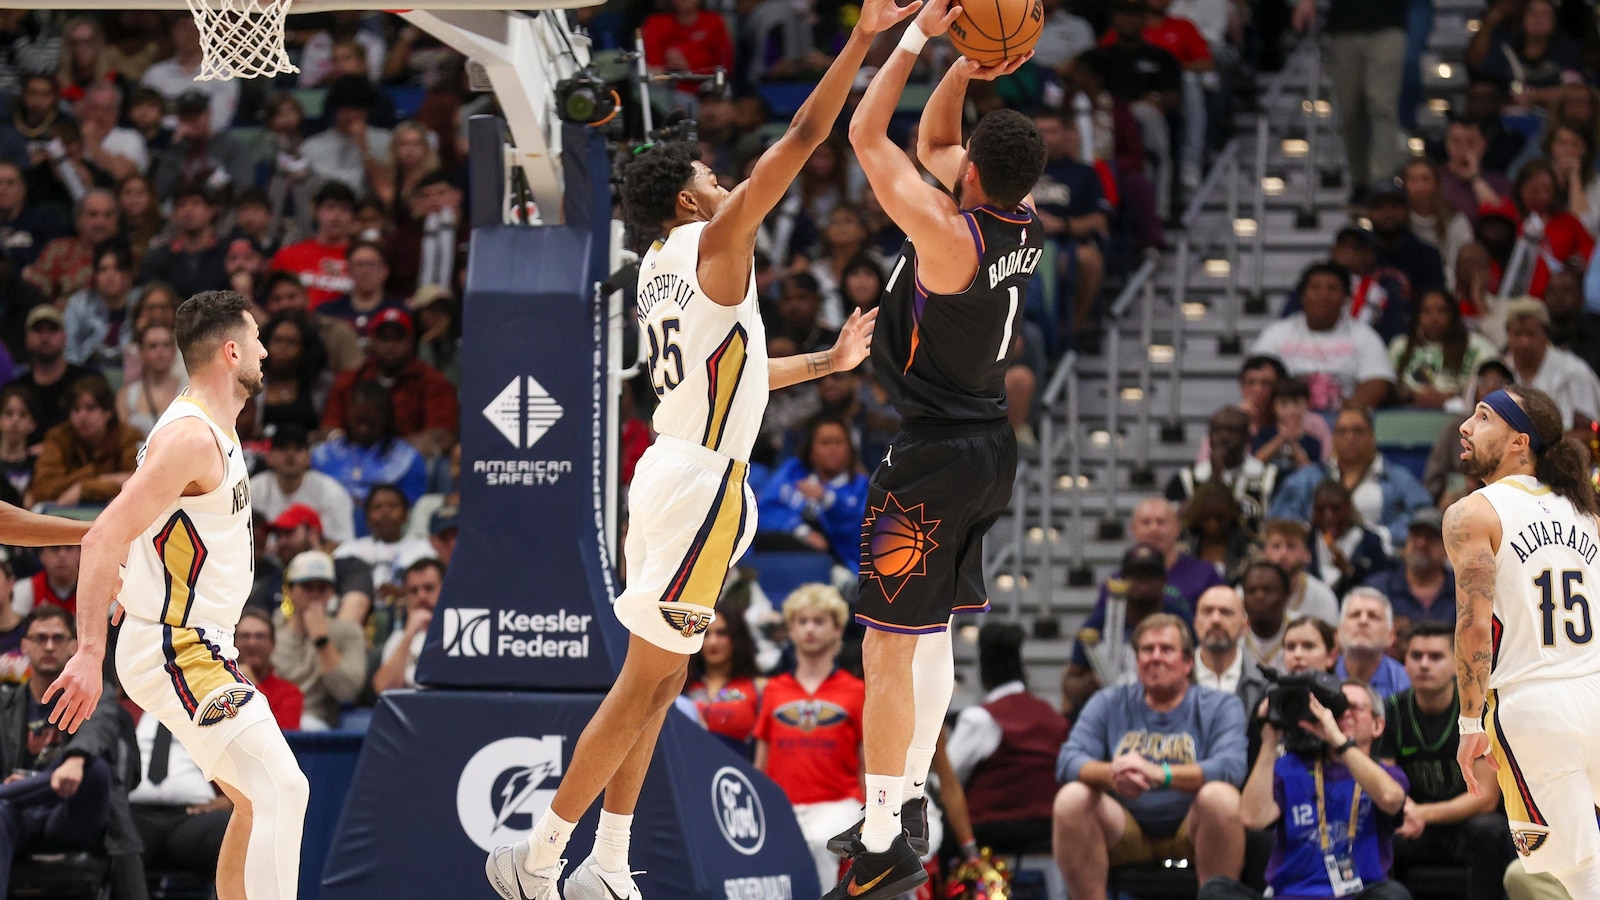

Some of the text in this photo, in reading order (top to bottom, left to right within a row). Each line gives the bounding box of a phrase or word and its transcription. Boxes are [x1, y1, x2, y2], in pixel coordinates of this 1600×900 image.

[987, 248, 1043, 290] BOOKER
[637, 273, 695, 324] MURPHY III
[995, 286, 1019, 362] 1
[646, 316, 686, 398] 25
[592, 280, 617, 604] NEWAGEPRODUCTS.COM
[474, 460, 572, 473] AMERICAN
[486, 473, 560, 485] SAFETY
[1510, 520, 1598, 565] ALVARADO
[497, 609, 593, 632] Keesler
[1532, 567, 1595, 649] 15
[497, 634, 590, 658] Federal
[1113, 729, 1198, 764] PELICANS
[720, 778, 759, 839] Ford
[1292, 803, 1315, 827] 12
